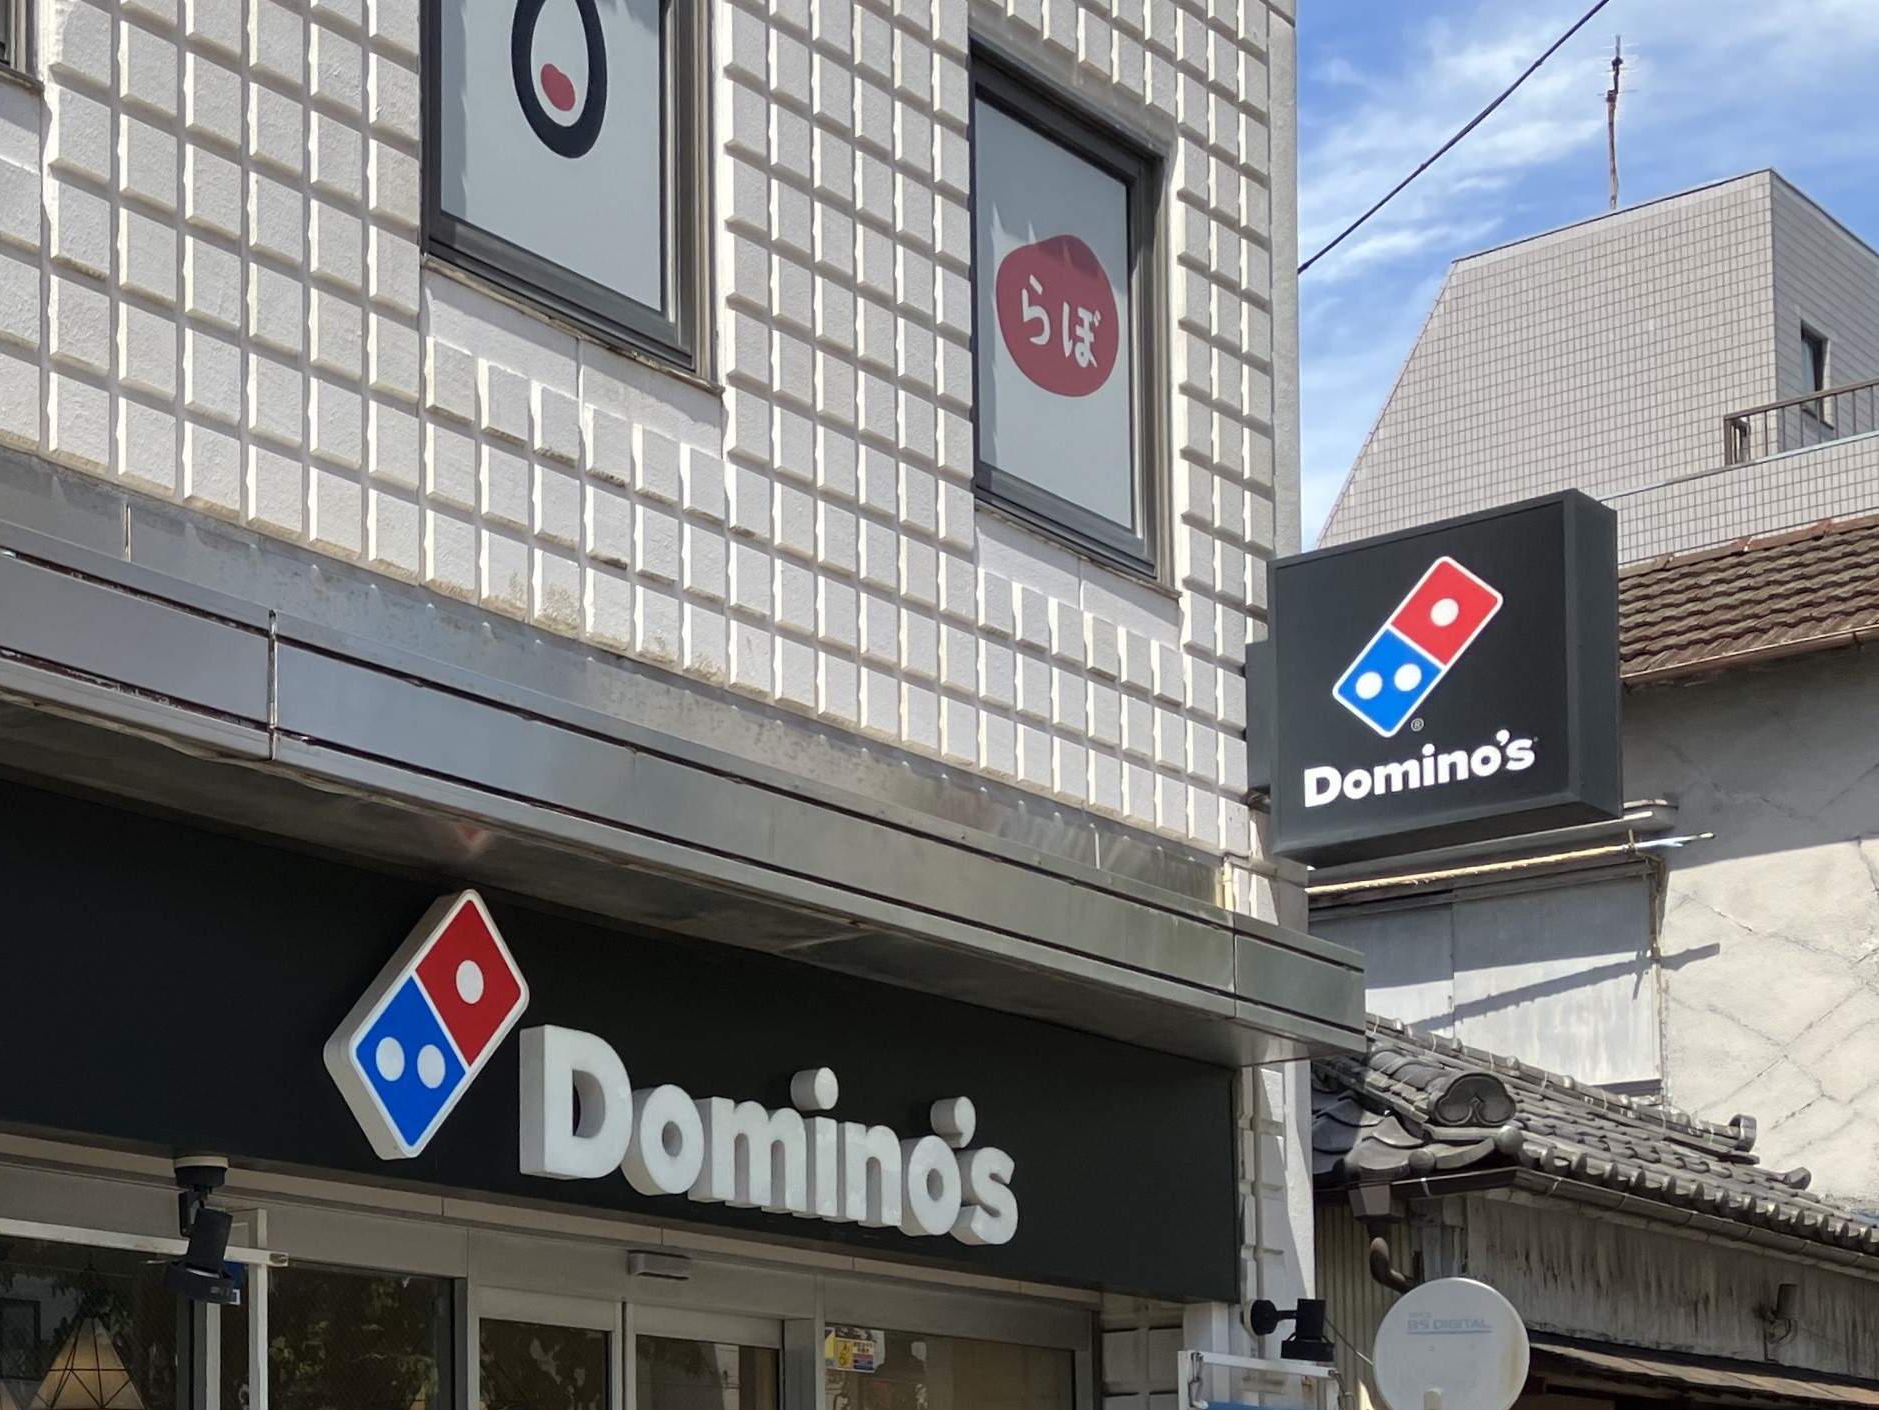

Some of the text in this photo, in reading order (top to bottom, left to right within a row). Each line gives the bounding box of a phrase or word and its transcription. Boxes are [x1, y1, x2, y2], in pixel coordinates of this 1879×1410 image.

[1018, 272, 1102, 369] らぼ
[1303, 729, 1535, 808] Domino's
[519, 1024, 1019, 1247] Domino's
[1433, 1317, 1492, 1330] DIGITAL
